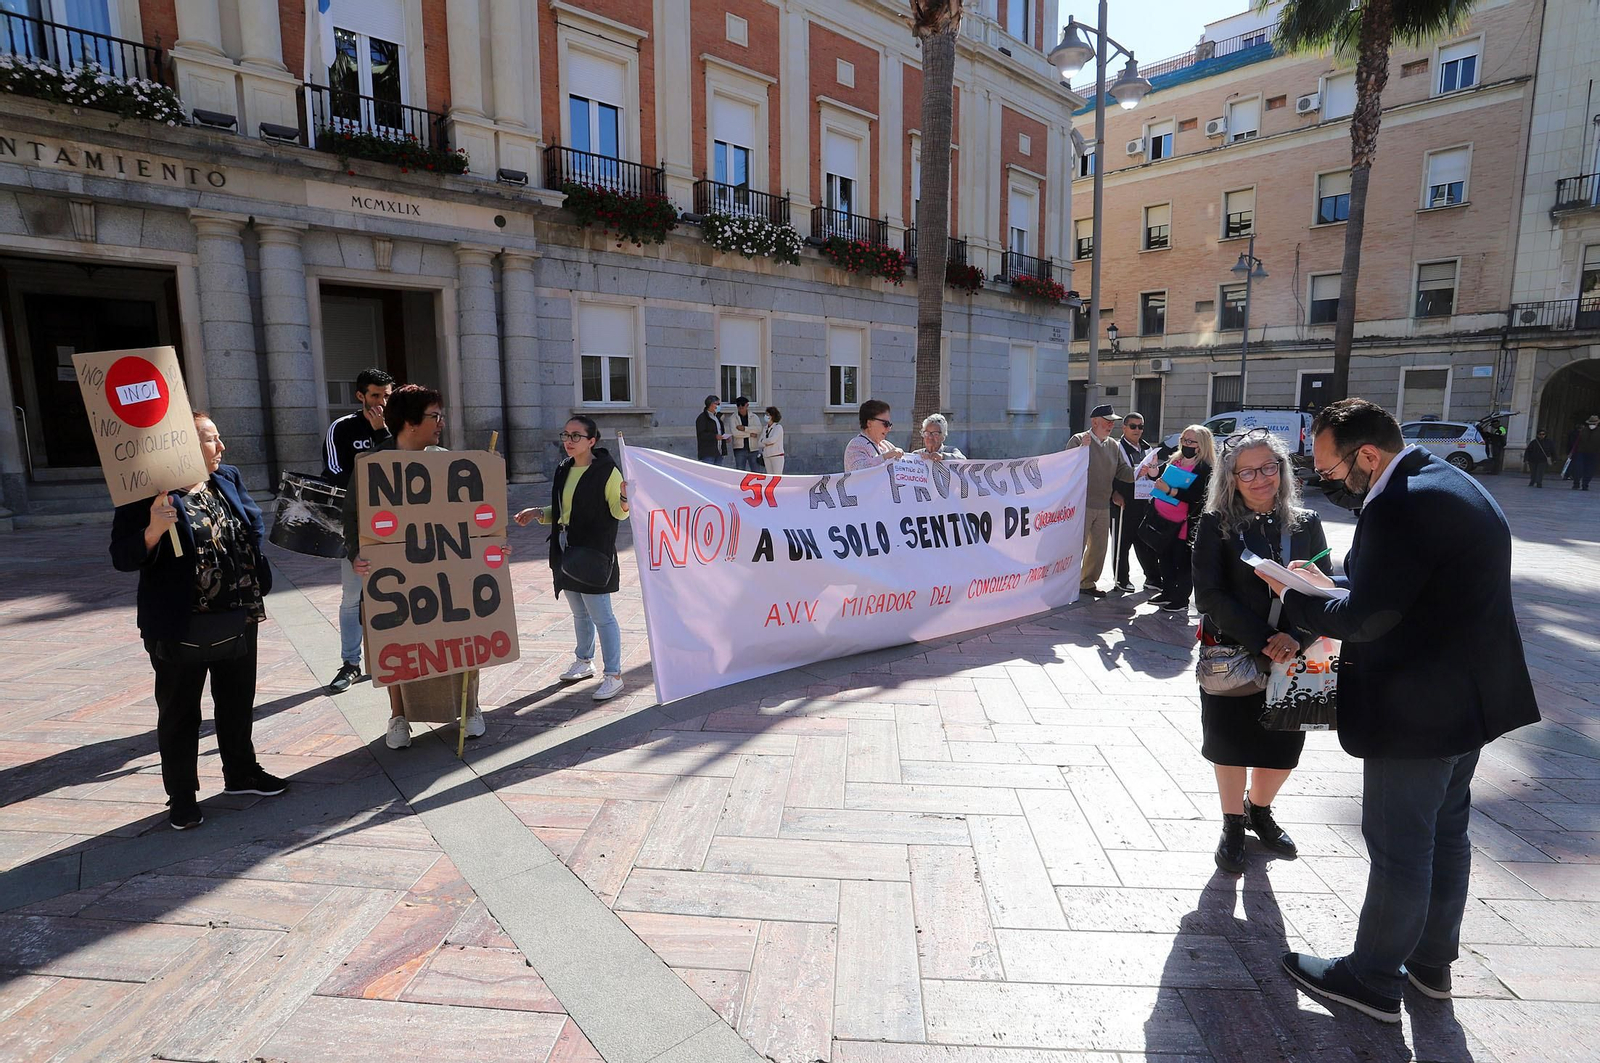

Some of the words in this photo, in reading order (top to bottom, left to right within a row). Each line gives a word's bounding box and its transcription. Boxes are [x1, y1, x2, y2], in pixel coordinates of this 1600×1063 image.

[351, 196, 421, 216] MCMXLIX
[114, 429, 188, 462] CONQUERO
[367, 461, 432, 507] NO
[447, 458, 484, 503] A
[809, 473, 858, 509] AL
[405, 522, 472, 564] UN
[752, 528, 774, 562] A
[783, 528, 822, 561] UN
[828, 521, 891, 560] SOLO
[900, 511, 992, 549] SENTIDO
[1004, 506, 1030, 539] DE
[842, 590, 917, 617] MIRADOR
[929, 585, 952, 607] DEL
[968, 573, 1021, 599] CONQUERO
